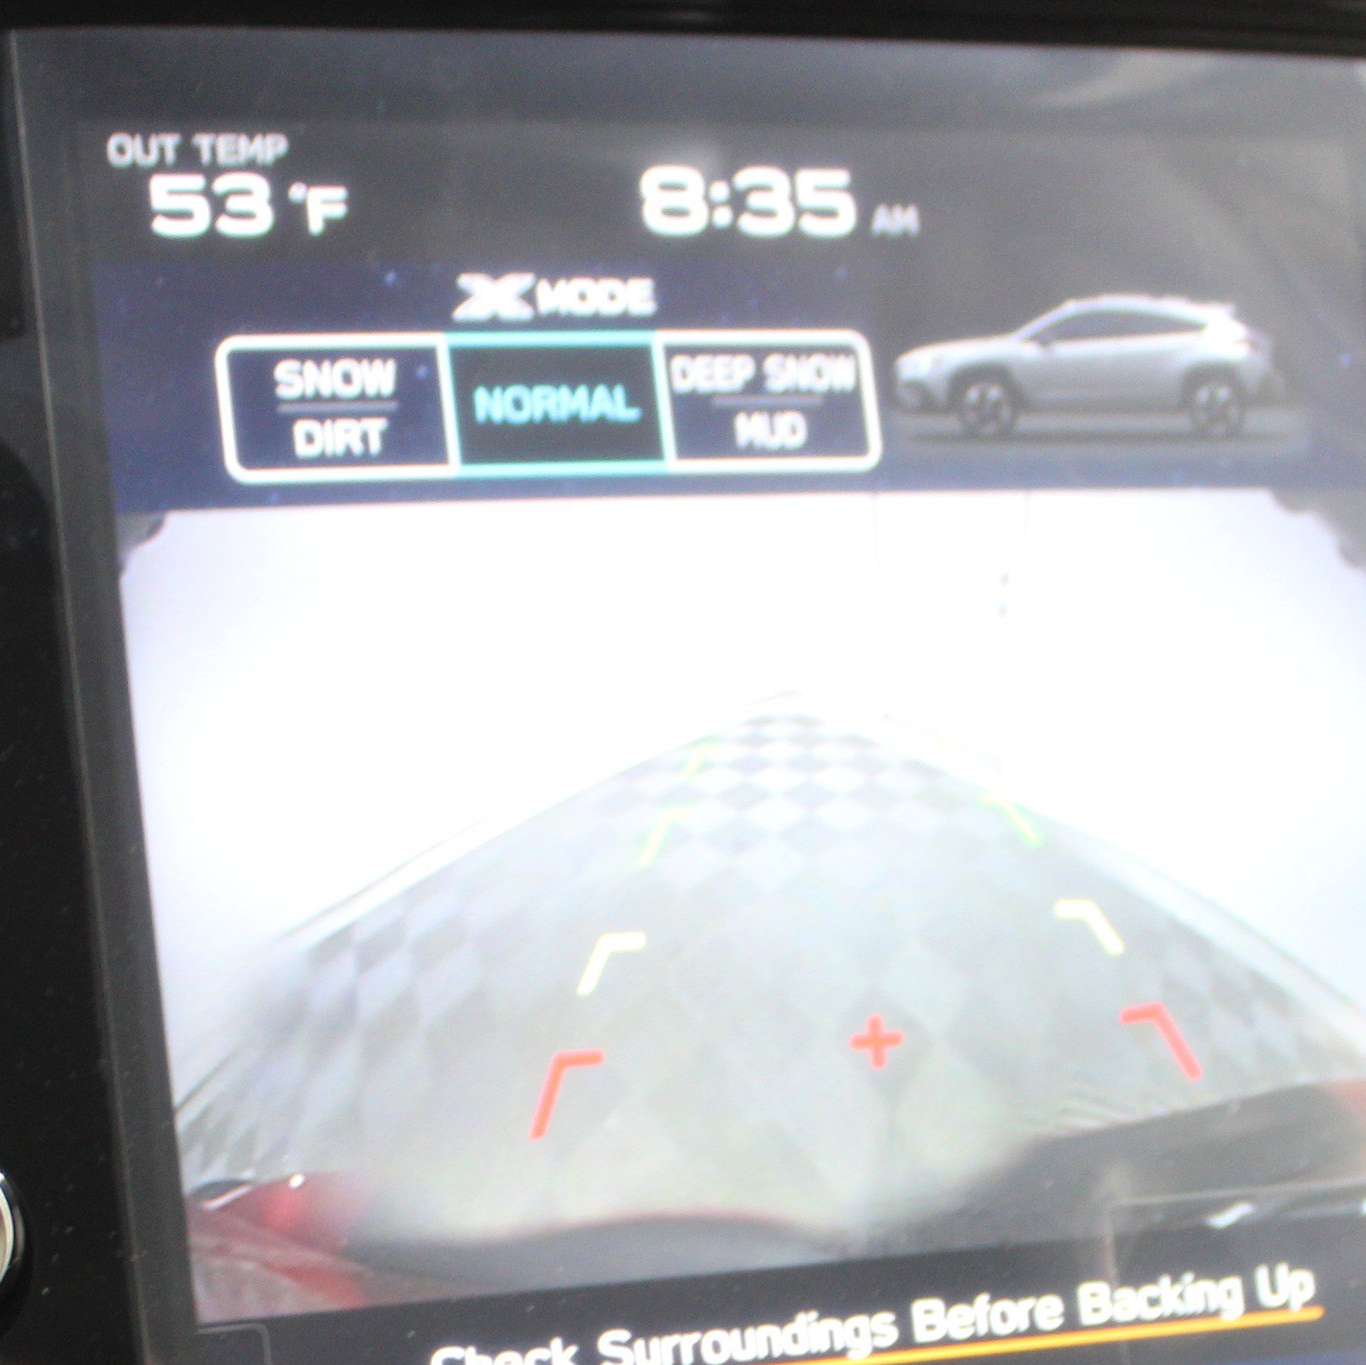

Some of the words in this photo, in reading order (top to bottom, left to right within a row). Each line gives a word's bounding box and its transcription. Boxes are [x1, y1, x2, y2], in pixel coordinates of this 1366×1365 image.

[107, 133, 180, 167] OUT
[192, 132, 289, 166] TEMP
[149, 172, 275, 237] 53
[638, 166, 858, 237] 8:35
[871, 204, 920, 238] AM
[273, 358, 397, 399] SNOW
[671, 355, 755, 394] DEEP
[764, 353, 857, 393] SNOW
[474, 384, 641, 423] NORMAL
[293, 418, 389, 458] DIRT
[735, 411, 807, 450] MUD
[912, 1293, 1063, 1345] Before
[1077, 1270, 1245, 1327] Backing
[1257, 1262, 1317, 1311] Up
